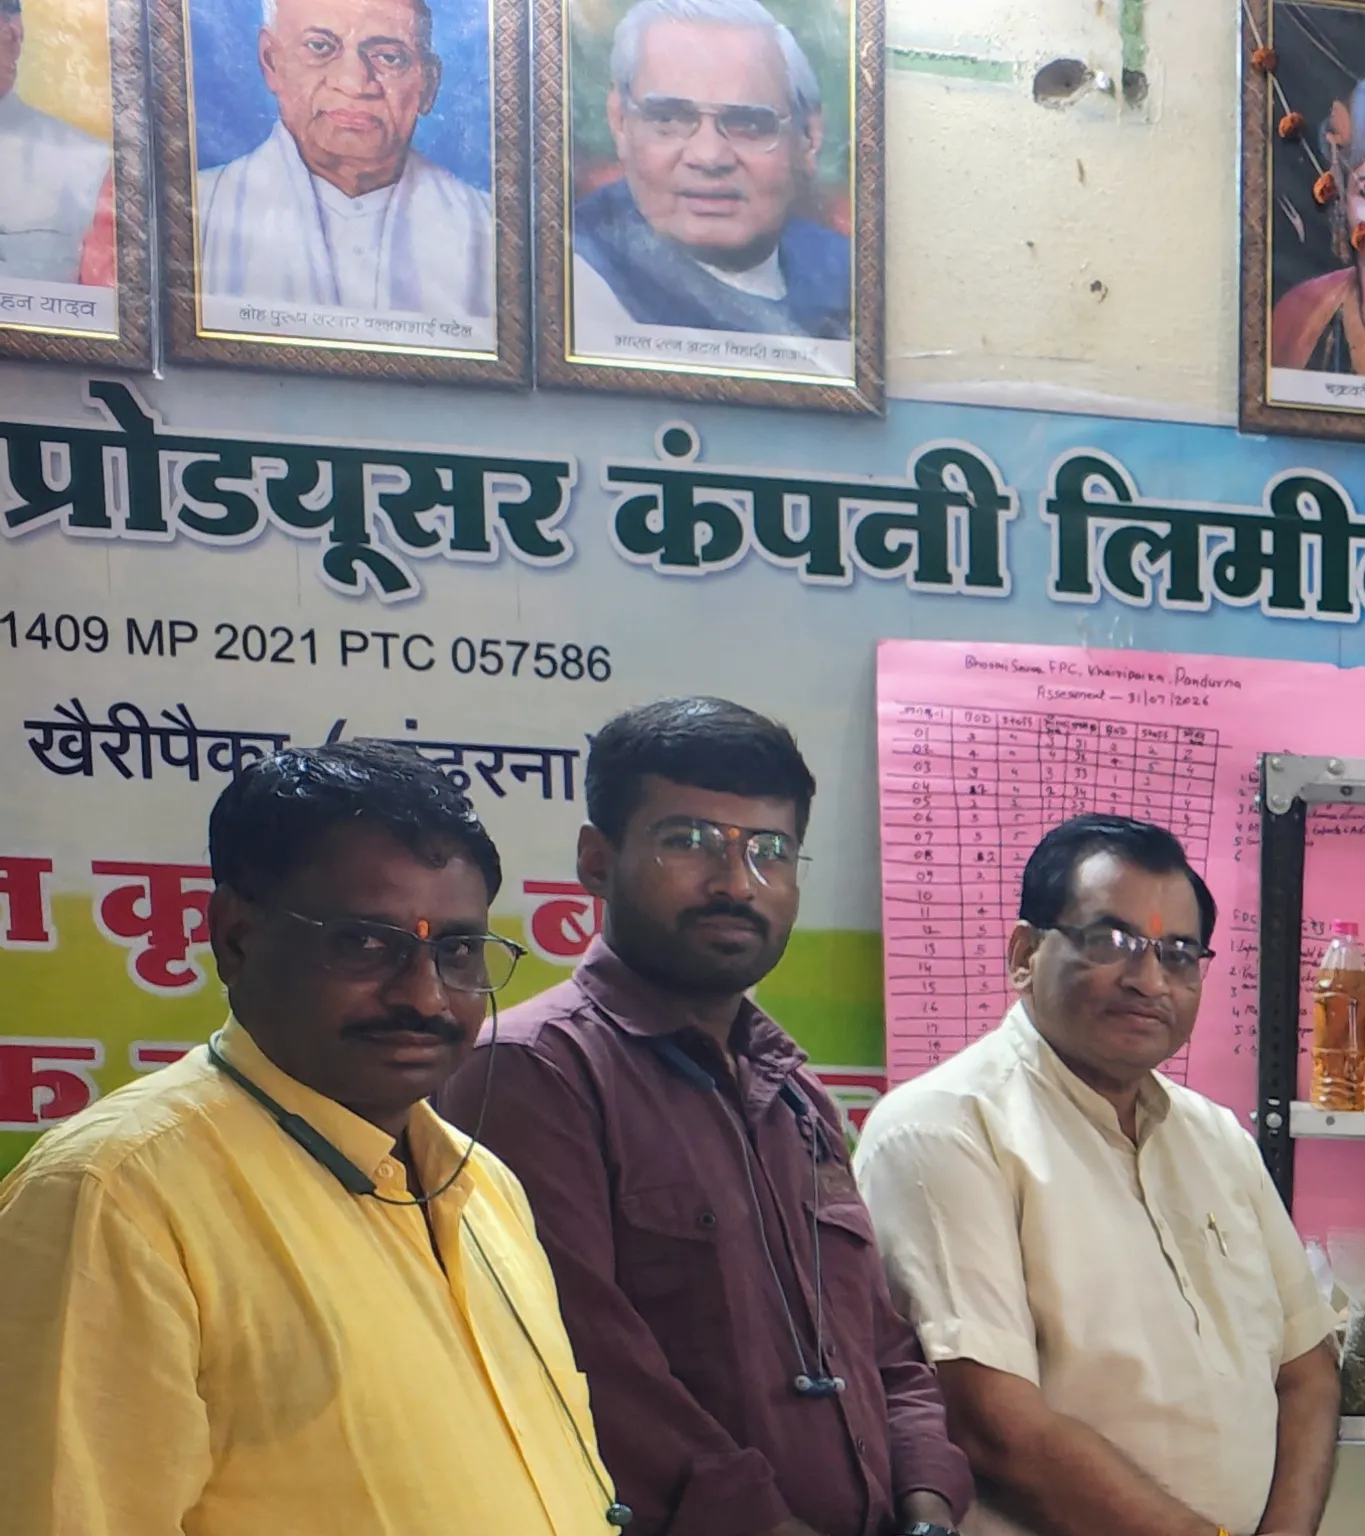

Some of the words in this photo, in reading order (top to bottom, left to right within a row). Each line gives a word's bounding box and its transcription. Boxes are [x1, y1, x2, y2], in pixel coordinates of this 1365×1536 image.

[40, 295, 97, 318] यादव
[607, 428, 1011, 590] कंपनी
[126, 616, 198, 657] MP
[214, 623, 320, 666] 2021
[339, 632, 437, 673] PTC
[450, 636, 613, 682] 057586
[914, 726, 931, 742] 01
[912, 760, 932, 774] 03
[912, 779, 931, 795] 04
[912, 795, 931, 810] 05
[912, 811, 934, 823] 06
[914, 830, 934, 845] 07
[916, 869, 934, 883] 09
[917, 889, 933, 901] 10
[920, 907, 930, 918] 11
[924, 943, 935, 956] 13
[918, 961, 932, 977] 14
[922, 981, 936, 994] 15
[922, 1002, 938, 1014] 16
[926, 1022, 938, 1034] 17
